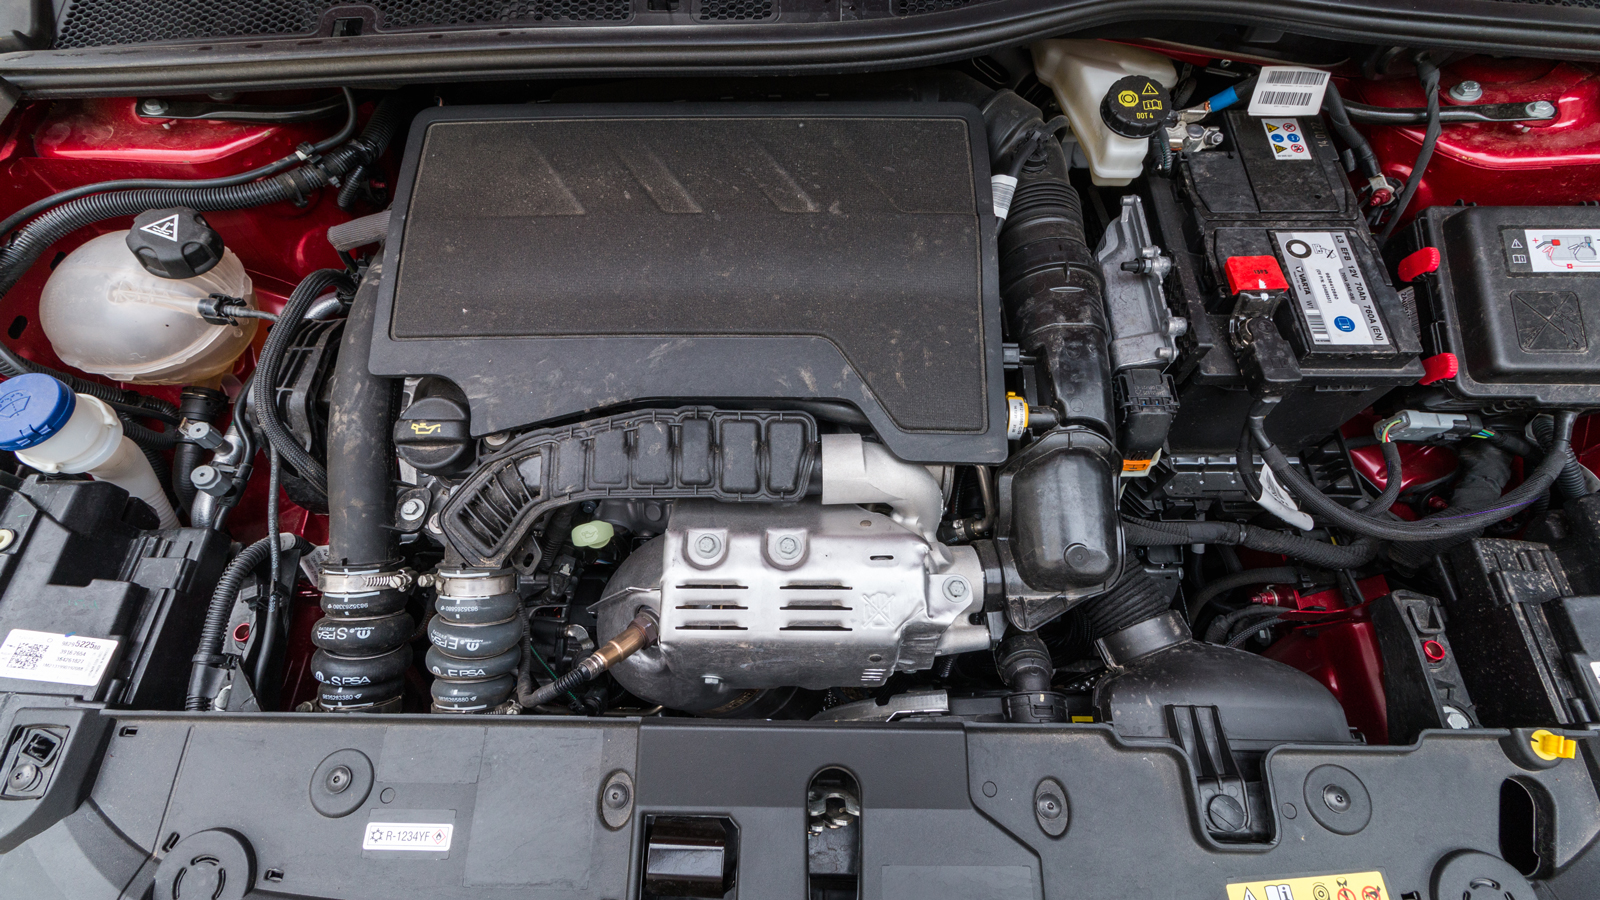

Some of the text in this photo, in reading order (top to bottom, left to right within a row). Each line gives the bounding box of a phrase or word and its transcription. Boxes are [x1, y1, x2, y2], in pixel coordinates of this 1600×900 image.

[1299, 274, 1311, 295] VARTA
[1336, 235, 1383, 341] L3 EFB 12V 70Ah 760A (EN)
[1306, 300, 1314, 308] W1
[317, 627, 348, 640] S PSA
[430, 633, 458, 650] E PSA
[331, 676, 371, 685] S PSA
[386, 831, 430, 841] R-1234YF
